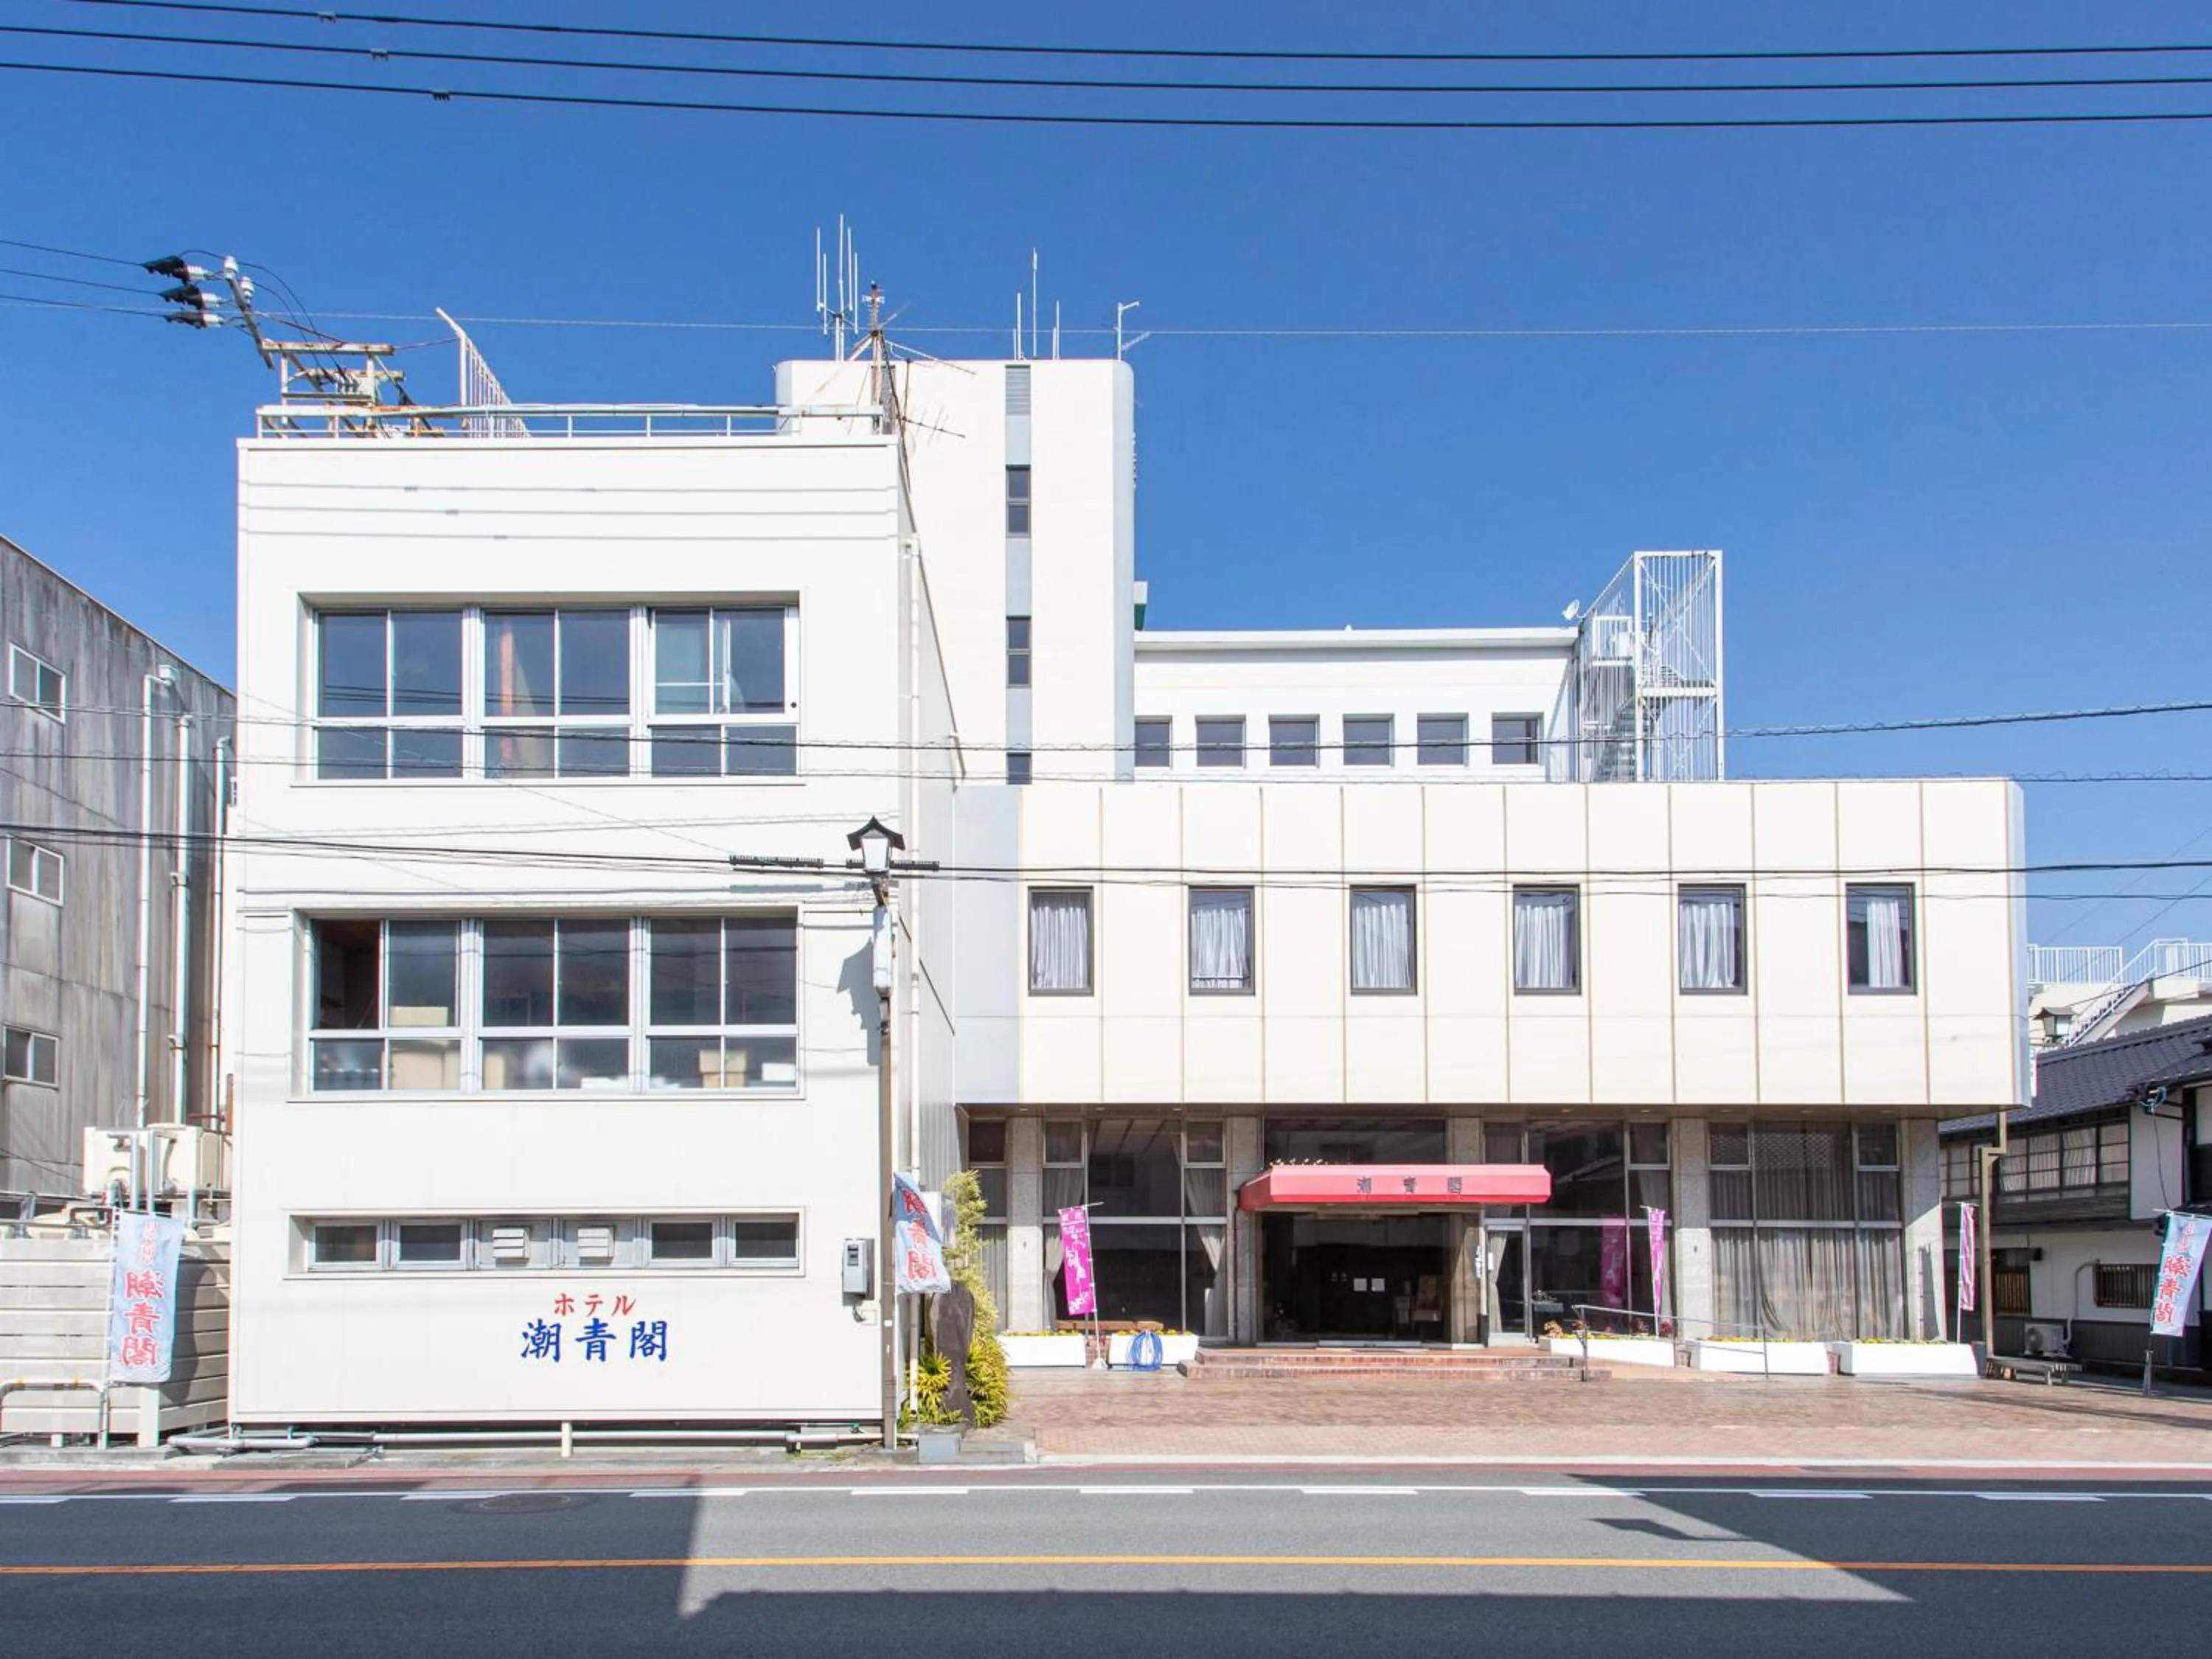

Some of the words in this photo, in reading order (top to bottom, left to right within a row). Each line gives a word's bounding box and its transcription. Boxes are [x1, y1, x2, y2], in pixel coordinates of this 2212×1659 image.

[554, 1293, 636, 1316] ホテル
[521, 1318, 667, 1363] 潮青閣
